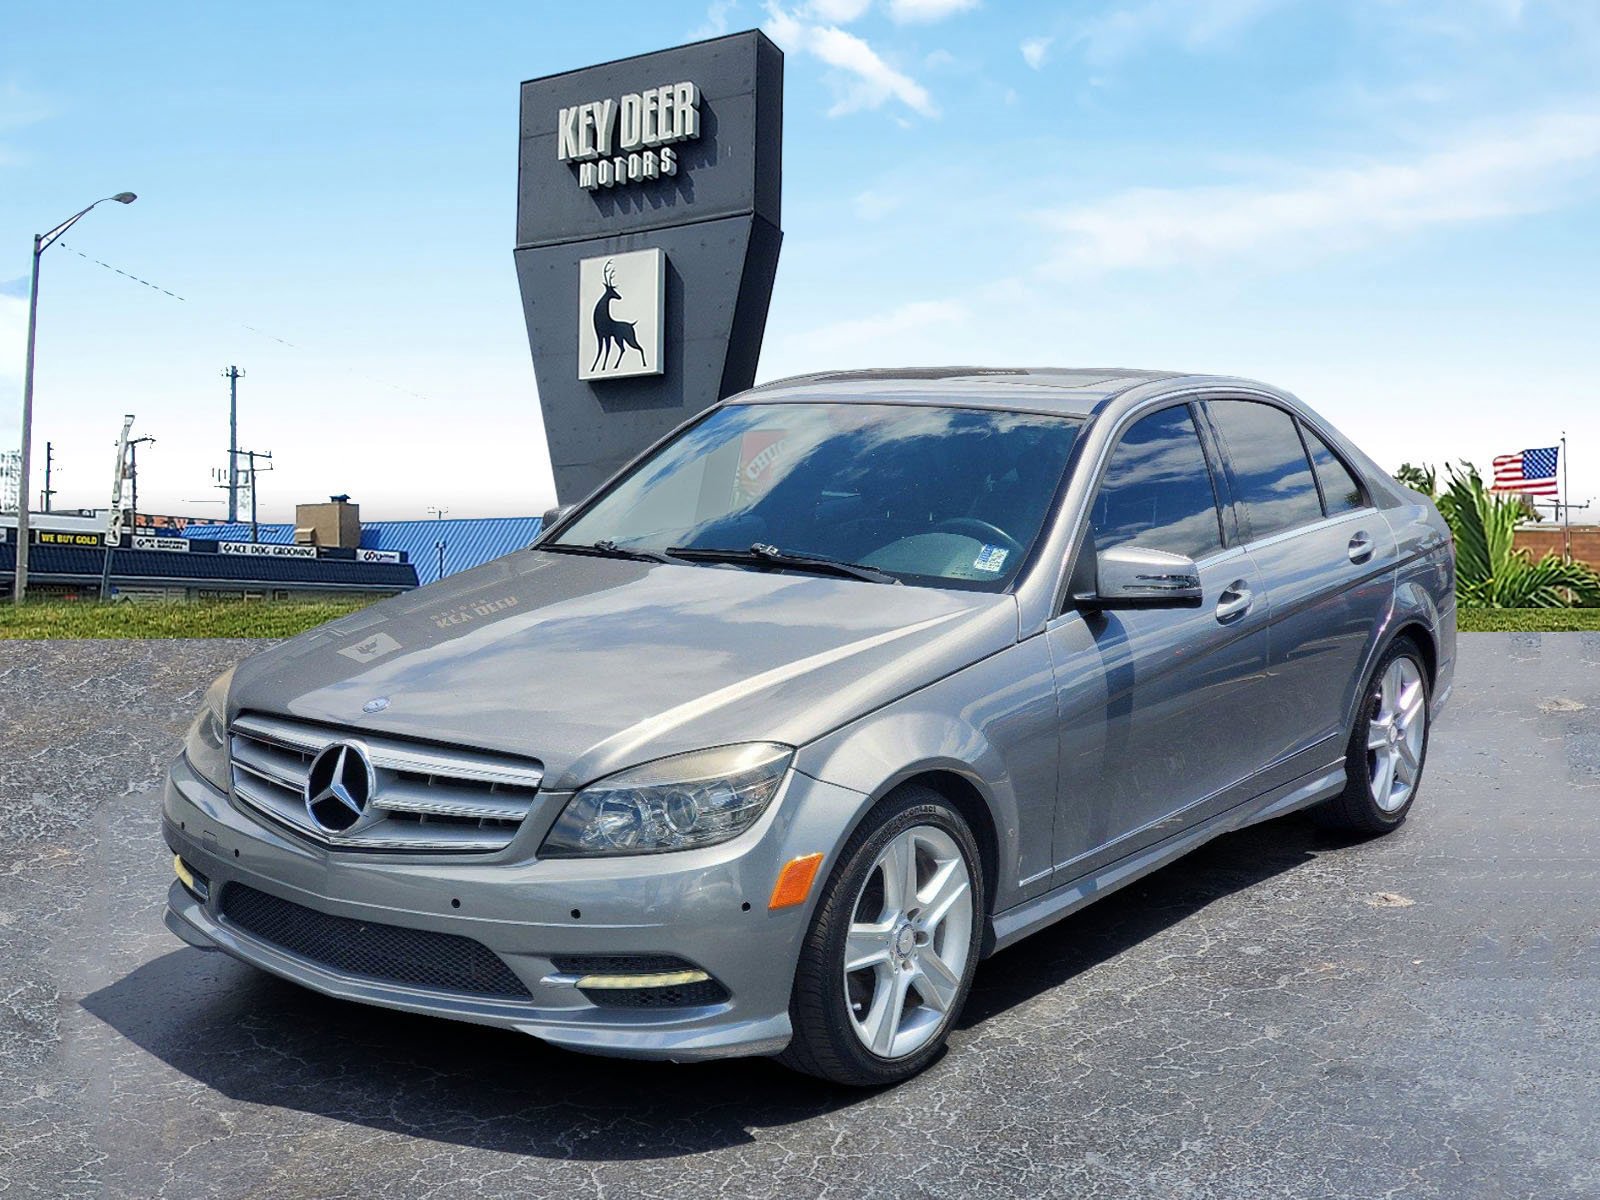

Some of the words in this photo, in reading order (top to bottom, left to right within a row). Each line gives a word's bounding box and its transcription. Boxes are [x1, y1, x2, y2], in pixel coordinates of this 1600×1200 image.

[558, 99, 616, 161] KEY
[620, 81, 699, 151] DEER
[579, 147, 676, 189] MOTORS
[42, 533, 55, 542] WE
[57, 534, 74, 544] BUY
[76, 535, 97, 545] GOLD
[232, 545, 247, 553] ACE
[251, 546, 270, 555] DOG
[273, 547, 315, 557] GROOMING
